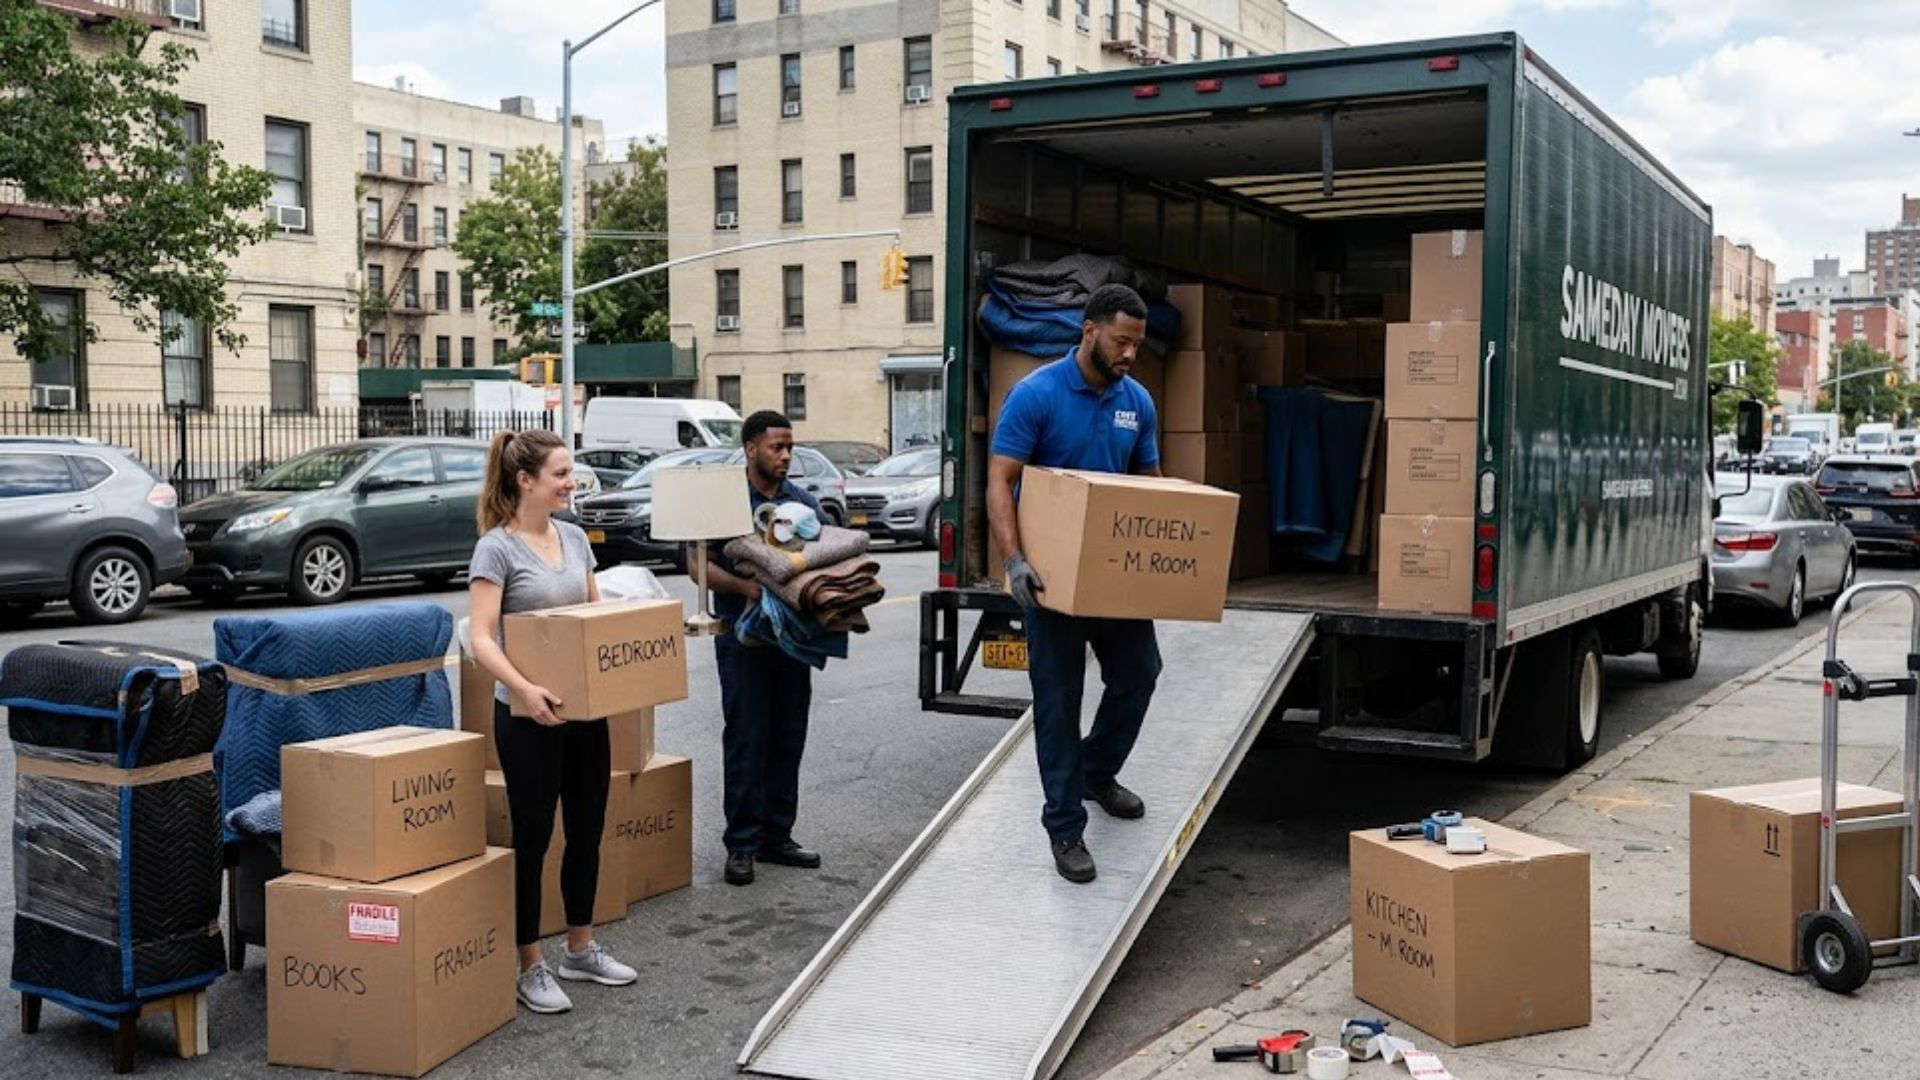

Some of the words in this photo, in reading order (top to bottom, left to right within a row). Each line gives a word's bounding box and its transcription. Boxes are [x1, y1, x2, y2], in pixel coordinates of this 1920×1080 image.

[1560, 264, 1641, 358] SAMEDAY
[1641, 299, 1691, 372] MOVERS
[1112, 510, 1196, 541] KITCHEN
[1150, 551, 1198, 578] ROOM
[597, 634, 677, 673] BEDROOM
[392, 767, 456, 804] LIVING
[403, 799, 456, 833] ROOM
[1365, 887, 1427, 938] KITCHEN
[284, 955, 367, 996] BOOKS
[433, 927, 497, 986] FRAGILE
[1398, 938, 1435, 979] ROOM
